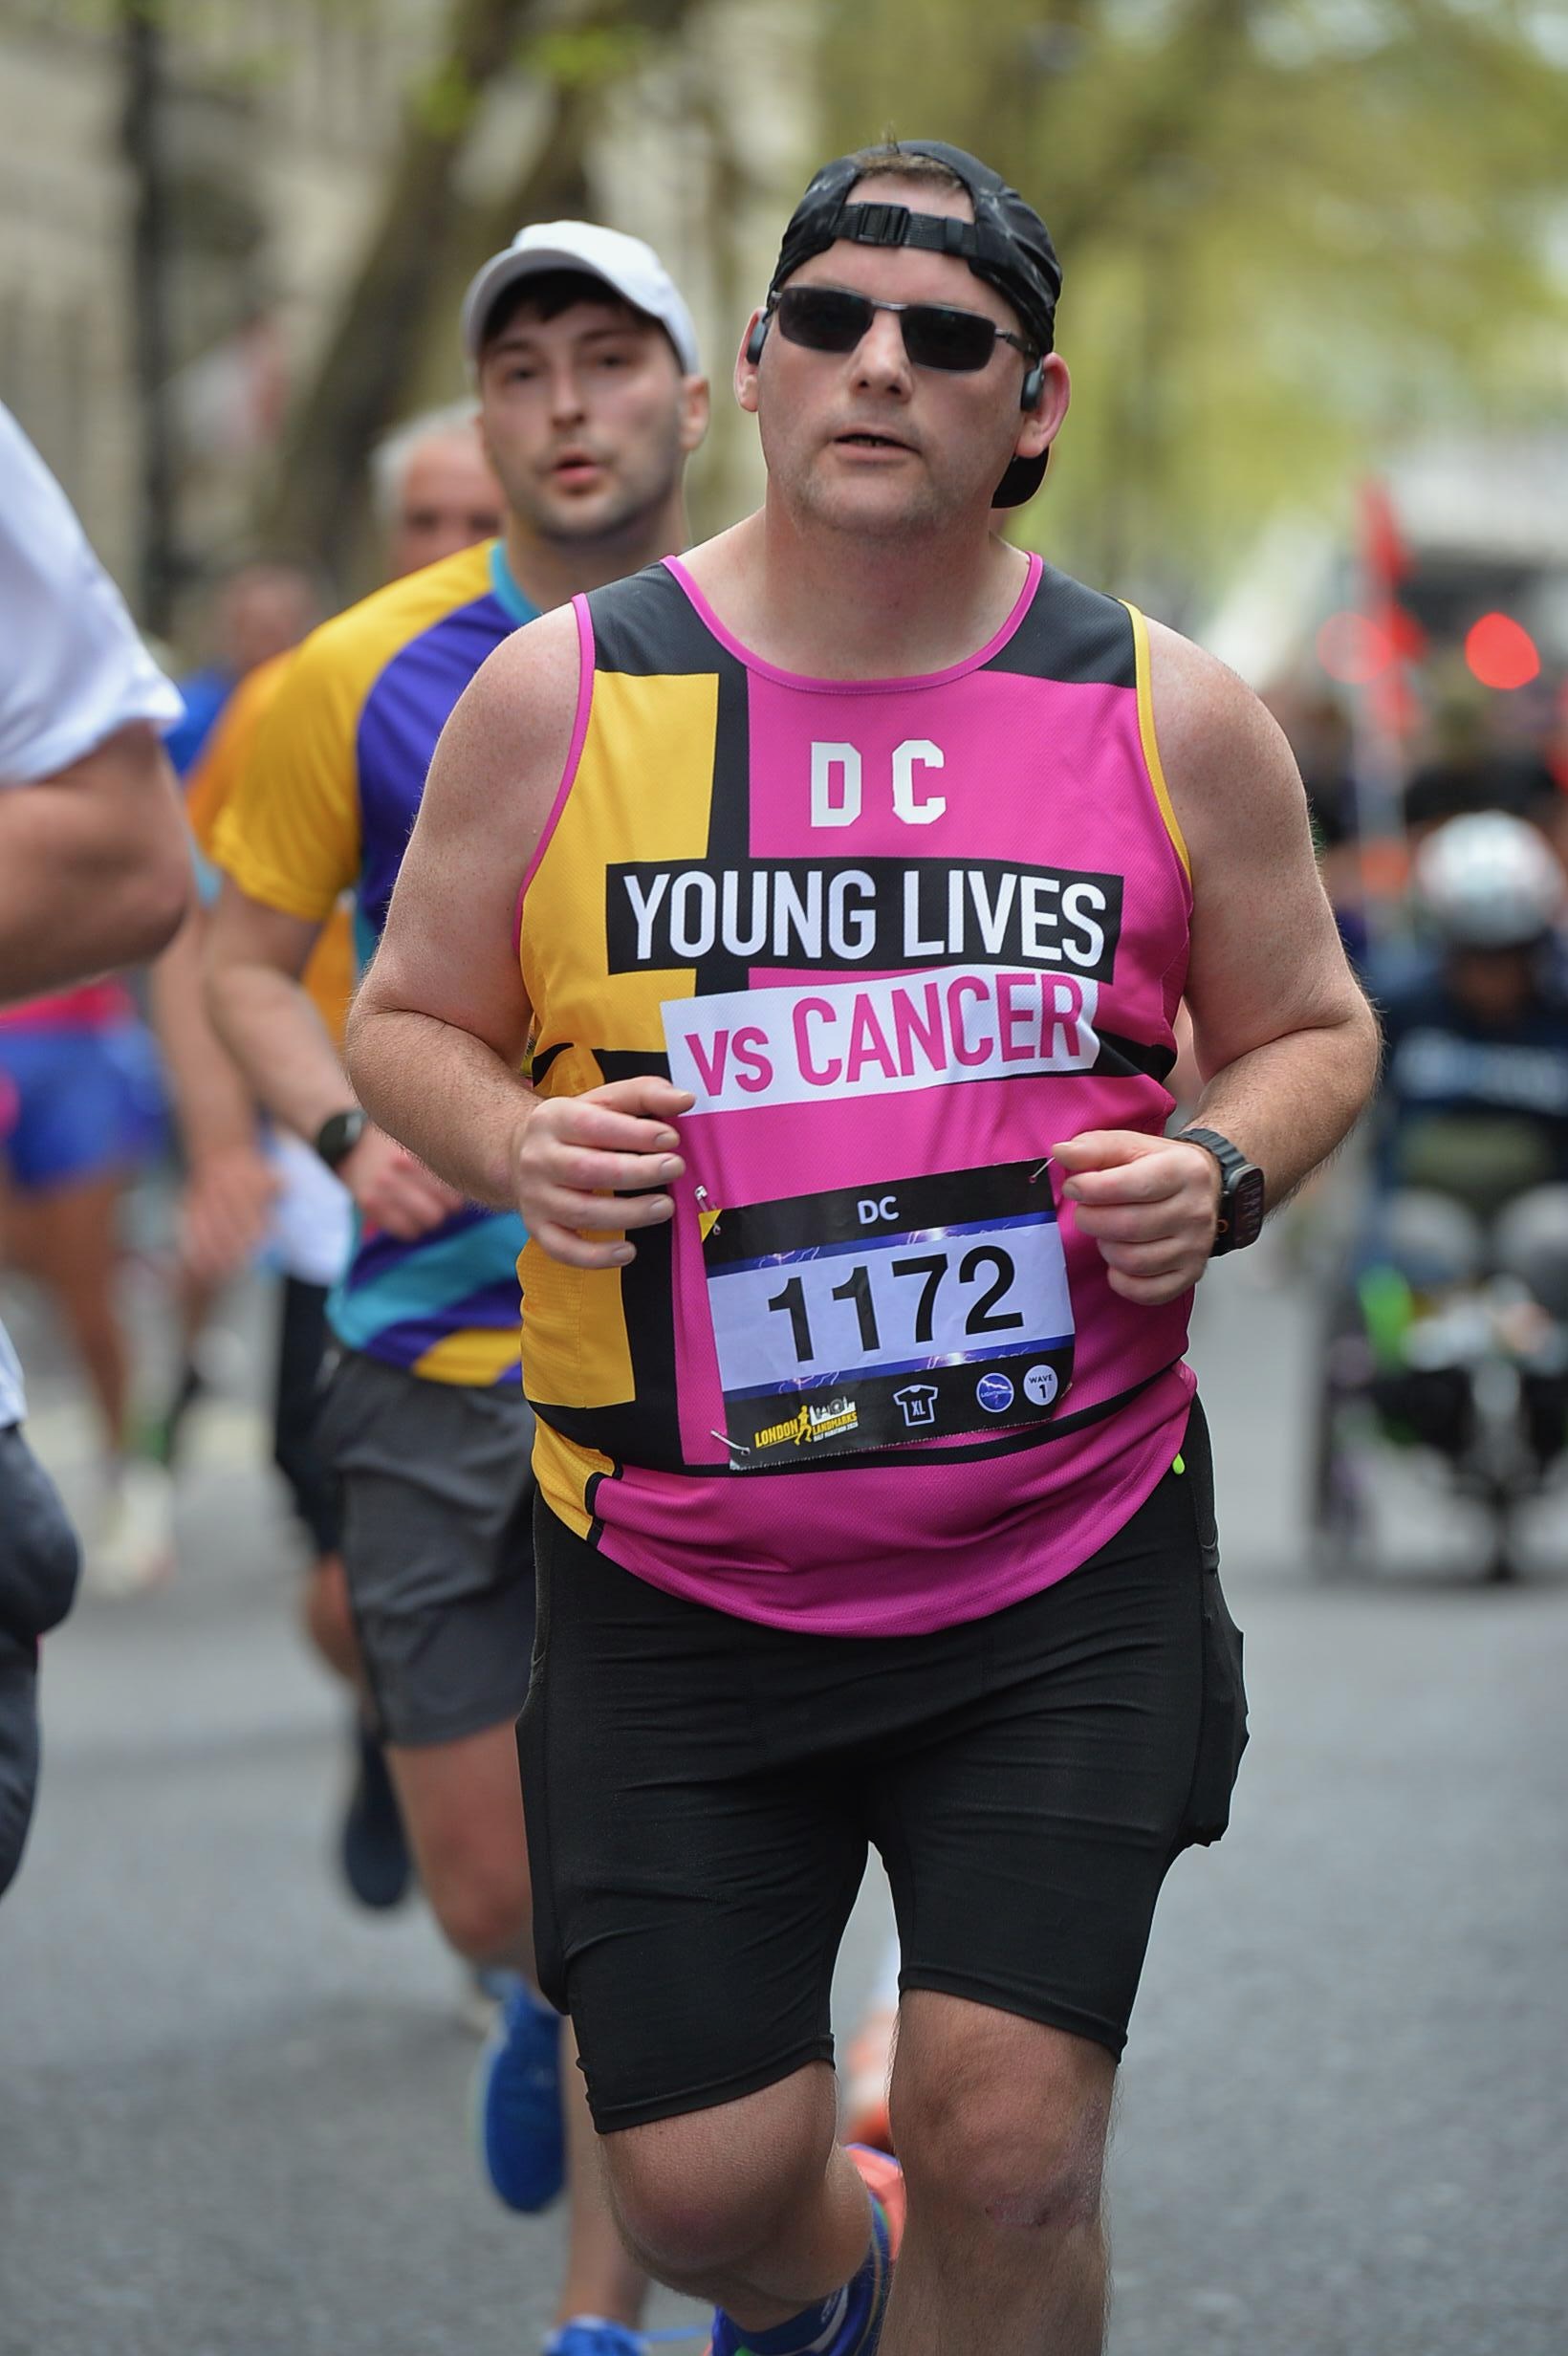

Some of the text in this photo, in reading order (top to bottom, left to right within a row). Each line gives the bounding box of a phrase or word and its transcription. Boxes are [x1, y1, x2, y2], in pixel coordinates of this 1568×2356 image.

[623, 869, 1106, 968] YOUNG LIVES
[793, 974, 1083, 1088] CANCER
[858, 1196, 900, 1225] DC
[768, 1245, 1024, 1363] 1172
[1029, 1374, 1053, 1384] WAVE
[1038, 1385, 1047, 1399] 1
[911, 1400, 926, 1416] XL
[754, 1418, 798, 1448] LONDON
[812, 1411, 858, 1434] LANDMARKS
